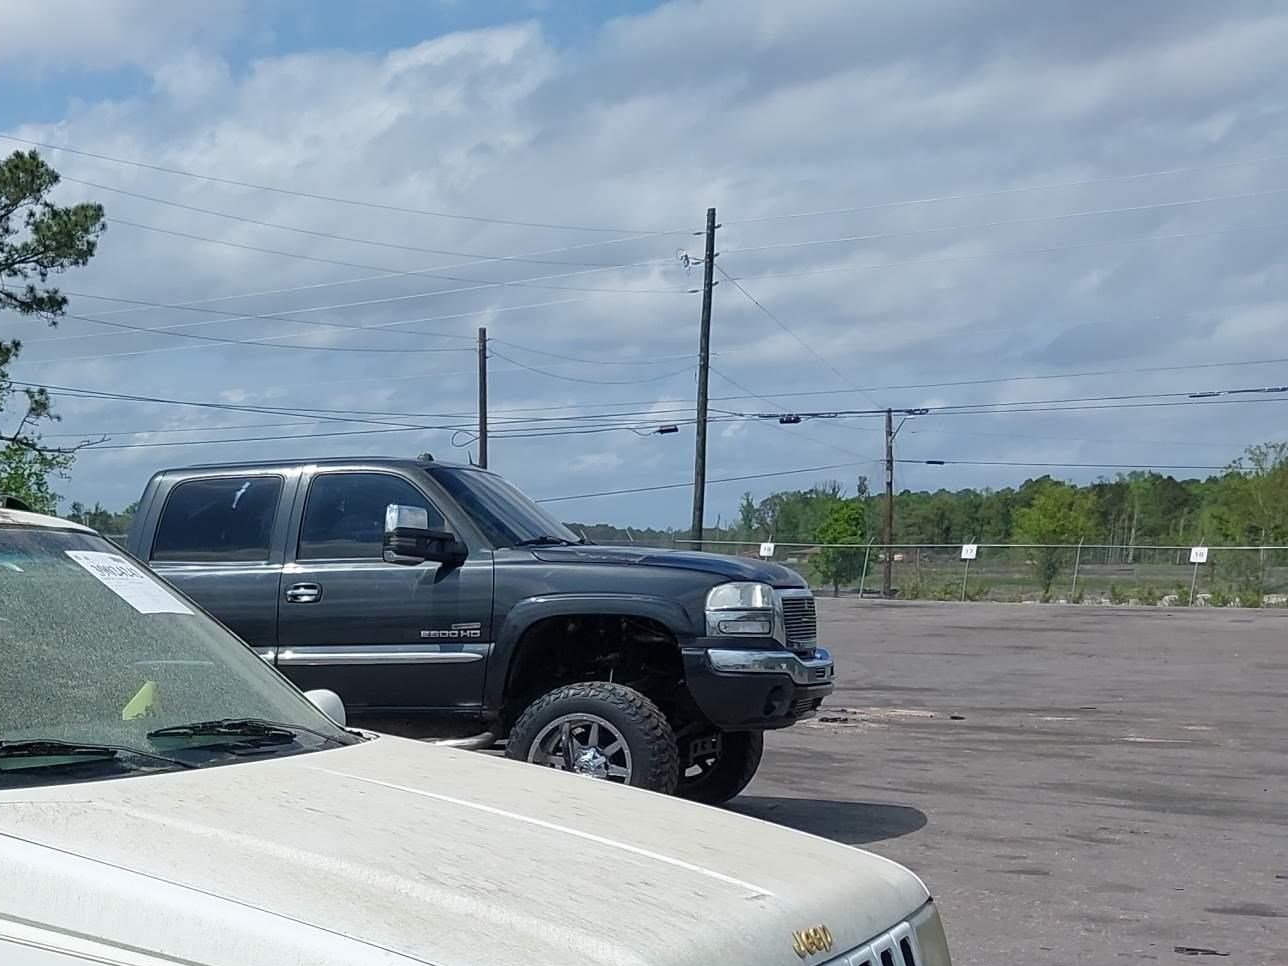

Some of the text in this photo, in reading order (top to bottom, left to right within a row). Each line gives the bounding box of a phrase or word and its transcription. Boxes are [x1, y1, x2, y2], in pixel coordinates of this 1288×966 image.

[420, 630, 481, 638] 2500 HD
[791, 925, 833, 958] Jeep
